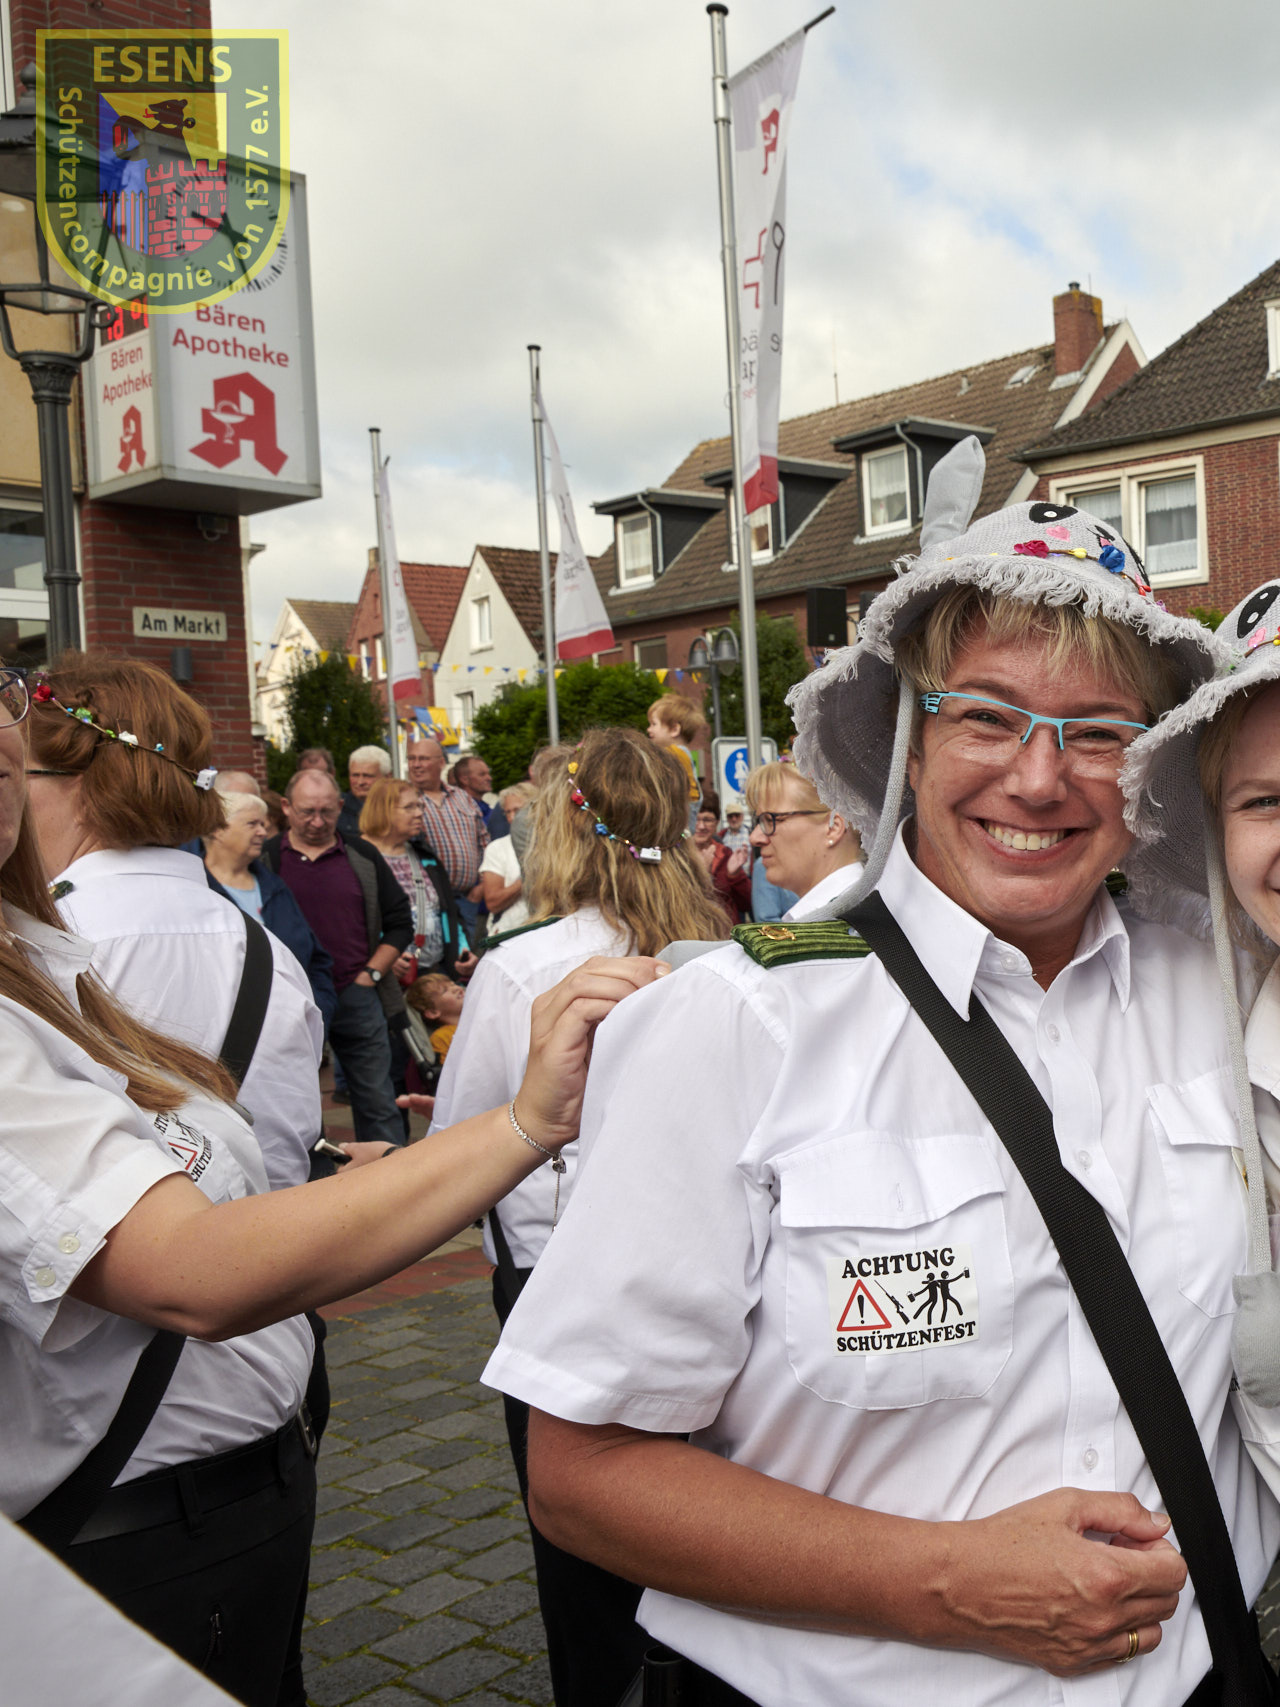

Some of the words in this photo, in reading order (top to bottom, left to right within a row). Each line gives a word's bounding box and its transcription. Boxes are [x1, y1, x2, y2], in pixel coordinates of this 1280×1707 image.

[195, 302, 266, 334] Bären
[111, 346, 143, 371] Bären
[172, 328, 289, 368] Apotheke
[141, 612, 168, 632] Am
[173, 614, 221, 635] Markt
[842, 1247, 955, 1279] ACHTUNG
[836, 1320, 977, 1352] SCHÜTZENFEST
